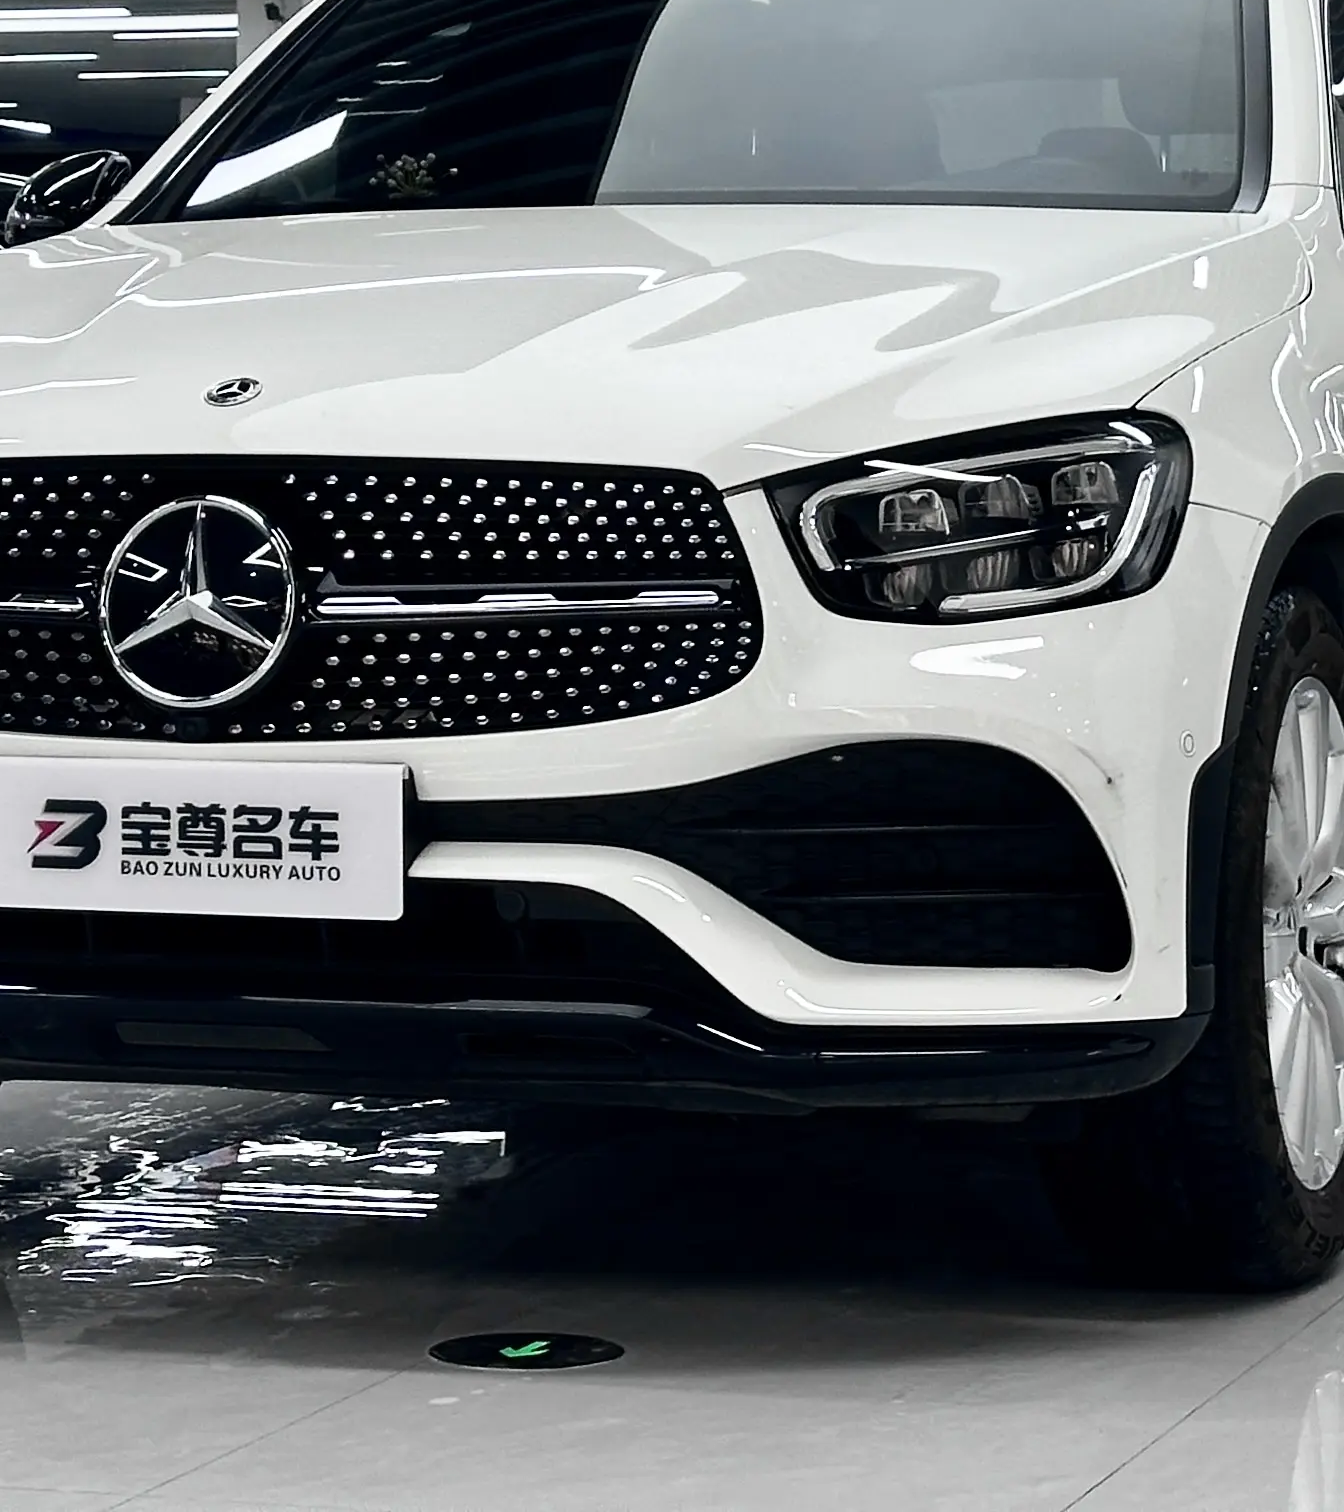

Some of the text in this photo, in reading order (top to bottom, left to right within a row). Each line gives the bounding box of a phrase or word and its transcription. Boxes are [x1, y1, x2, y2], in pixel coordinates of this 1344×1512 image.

[121, 802, 340, 861] 宝尊名车
[121, 860, 340, 881] BAO ZUN LUXURY AUTO
